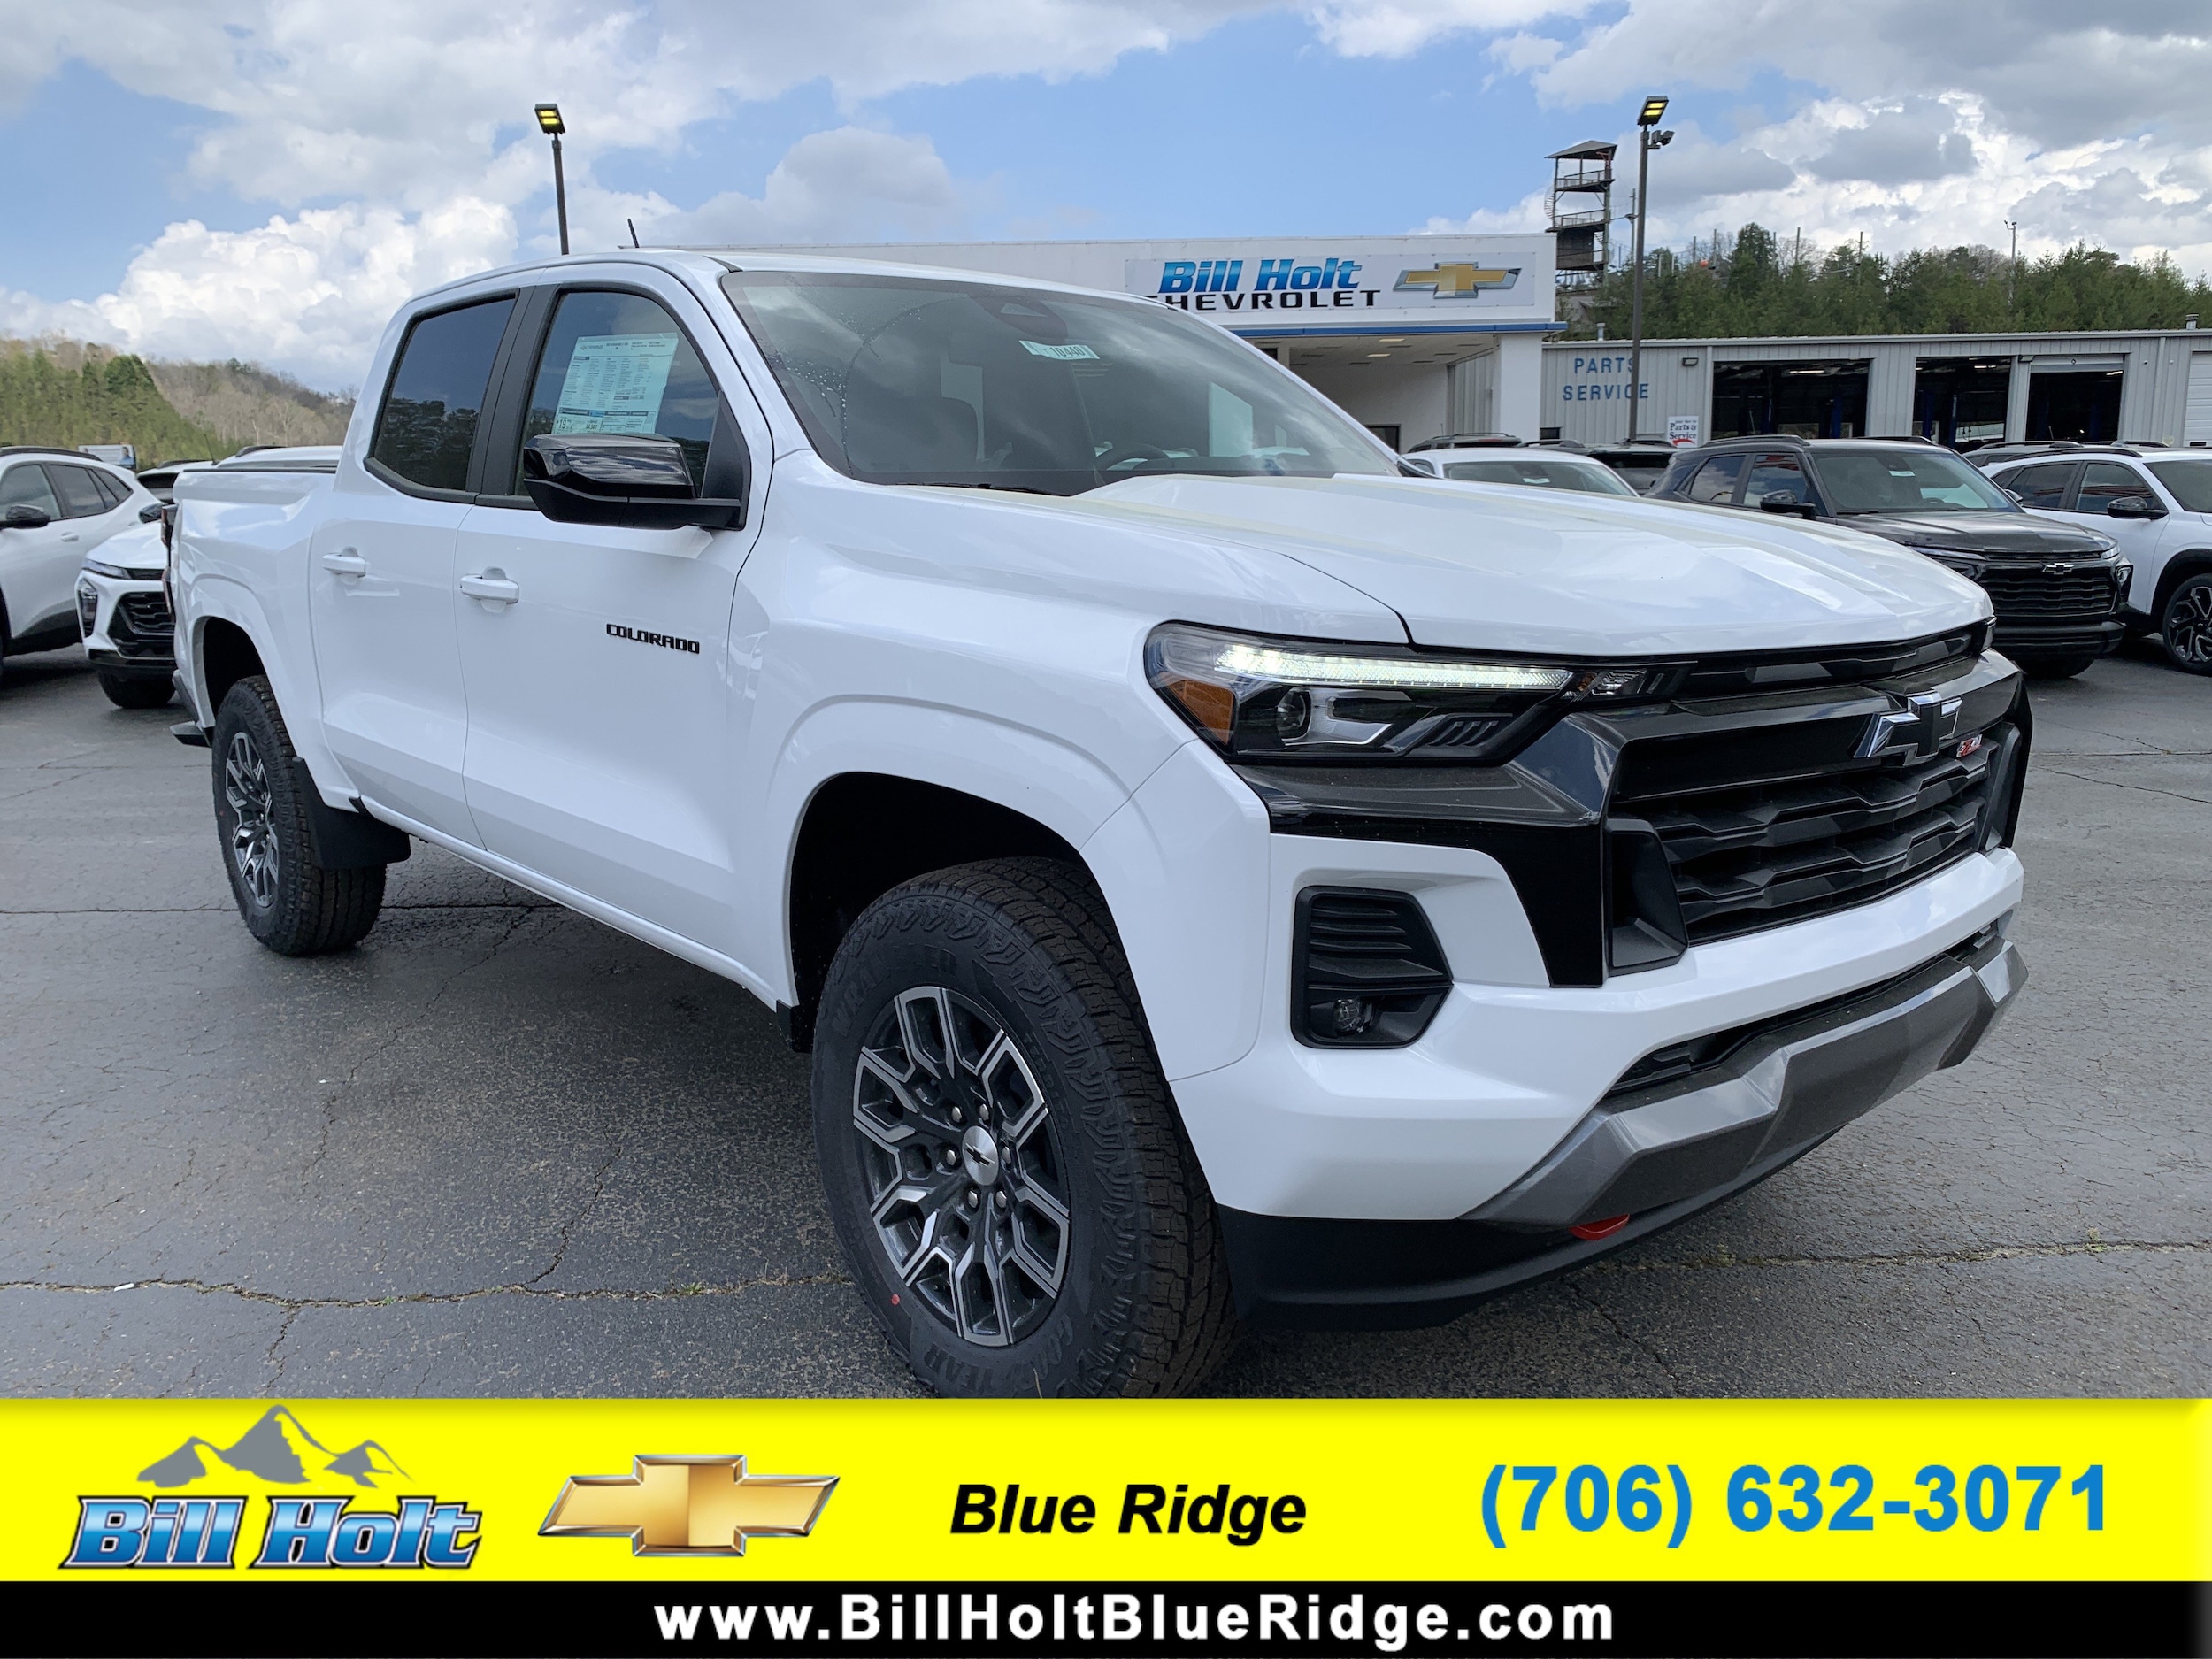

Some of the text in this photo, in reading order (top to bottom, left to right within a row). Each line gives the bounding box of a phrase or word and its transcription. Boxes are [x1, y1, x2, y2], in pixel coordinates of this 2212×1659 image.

[1157, 257, 1363, 294] Bill Holt
[1147, 289, 1381, 311] HEVROLET
[1563, 383, 1649, 401] SERVICE
[1669, 431, 1697, 440] Service
[1670, 422, 1690, 431] Parts
[606, 623, 700, 655] COLORADO
